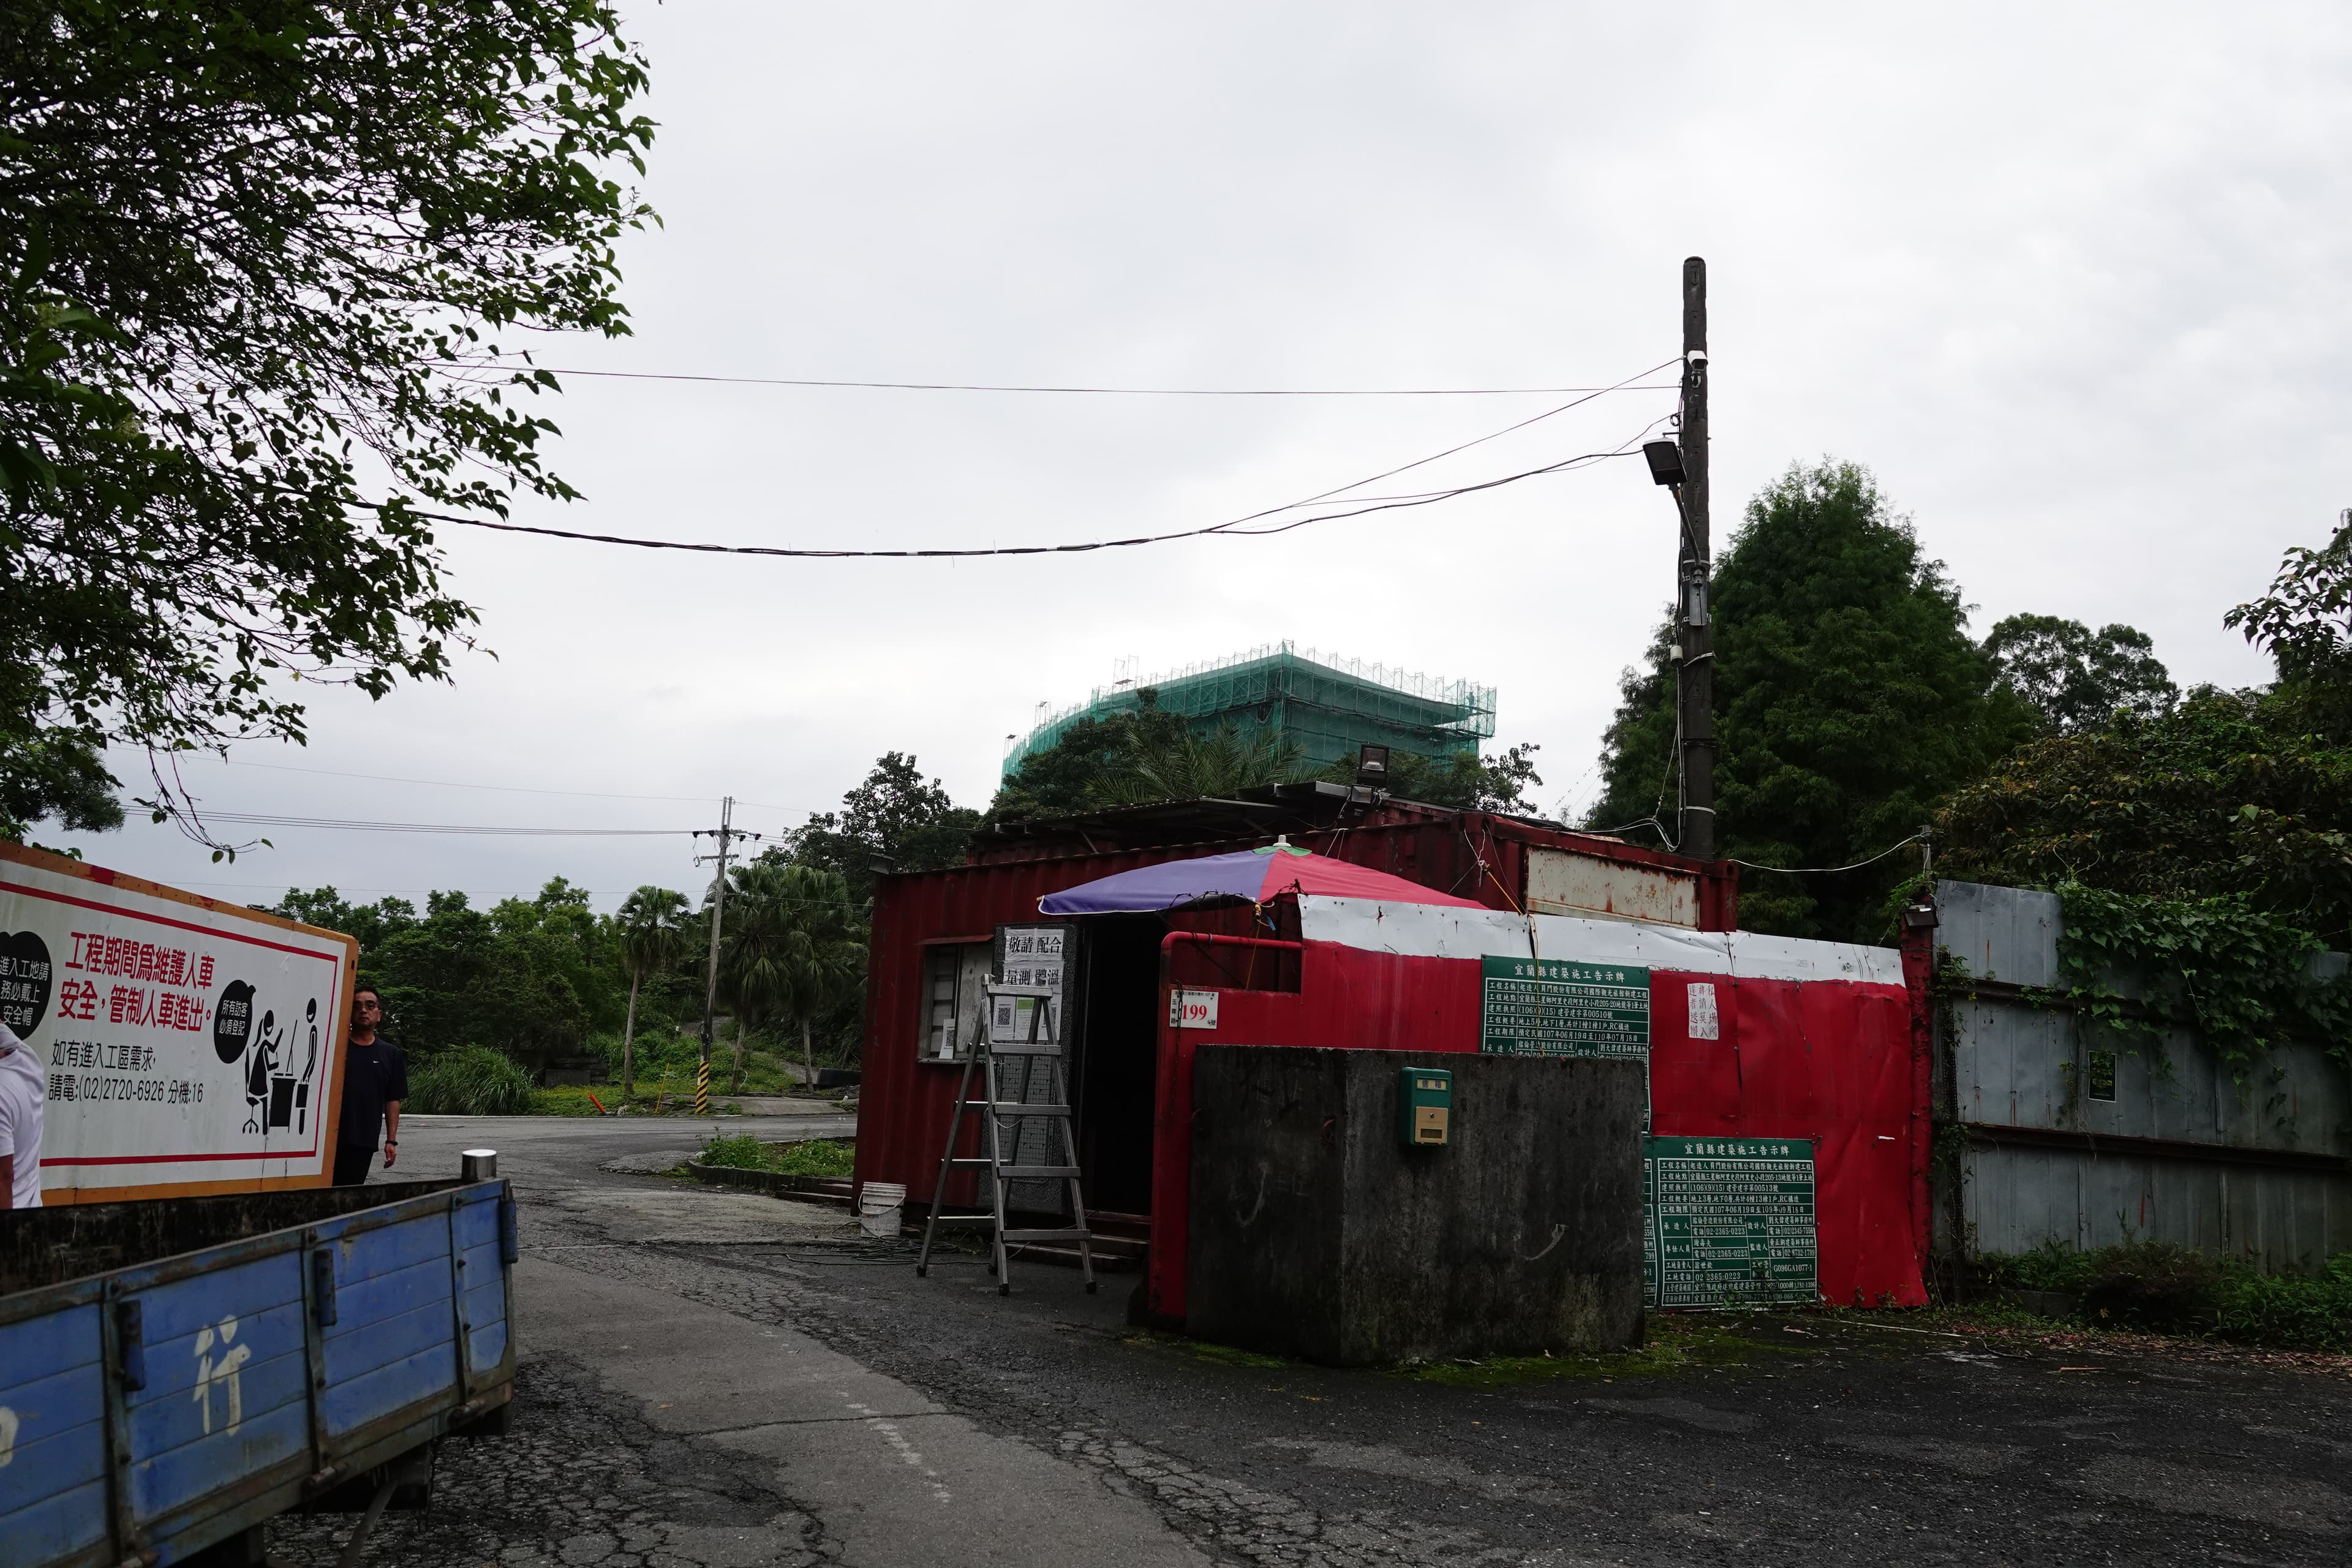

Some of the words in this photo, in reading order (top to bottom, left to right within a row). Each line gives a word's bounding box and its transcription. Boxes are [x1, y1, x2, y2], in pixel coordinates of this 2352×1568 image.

[1514, 963, 1625, 983] 宜蘭縣建築施工告示牌
[1488, 981, 1517, 991] 工程名稱
[0, 979, 40, 1004] 務必戴上
[1488, 993, 1517, 1003] 工程地點
[221, 999, 247, 1017] 所有訪客
[1182, 1004, 1207, 1020] 199
[1698, 985, 1709, 1038] 非請莫入
[3, 1005, 34, 1027] 安全帽
[1487, 1016, 1516, 1025] 工程概要
[219, 1018, 246, 1036] 必須登記
[1487, 1027, 1515, 1036] 工程期限
[1487, 1044, 1514, 1054] 承造人
[1684, 1142, 1790, 1157] 宜蘭縣建築施工告示牌
[1660, 1161, 1687, 1170] 工程名稱
[1660, 1172, 1688, 1181] 工程地點
[1660, 1194, 1687, 1203] 工程概要
[1661, 1205, 1689, 1214] 工程期限
[1663, 1221, 1690, 1231] 承造人
[1746, 1221, 1766, 1231] 設計人
[1768, 1226, 1781, 1236] 電話
[1692, 1227, 1705, 1236] 電話
[1705, 1227, 1745, 1235] 02-2365-0223
[1665, 1243, 1691, 1254] 專任人員
[1770, 1248, 1782, 1257] 電話
[1693, 1249, 1706, 1259] 電話
[1707, 1249, 1748, 1258] 02-2365-0223
[1665, 1272, 1691, 1281] 工地電話
